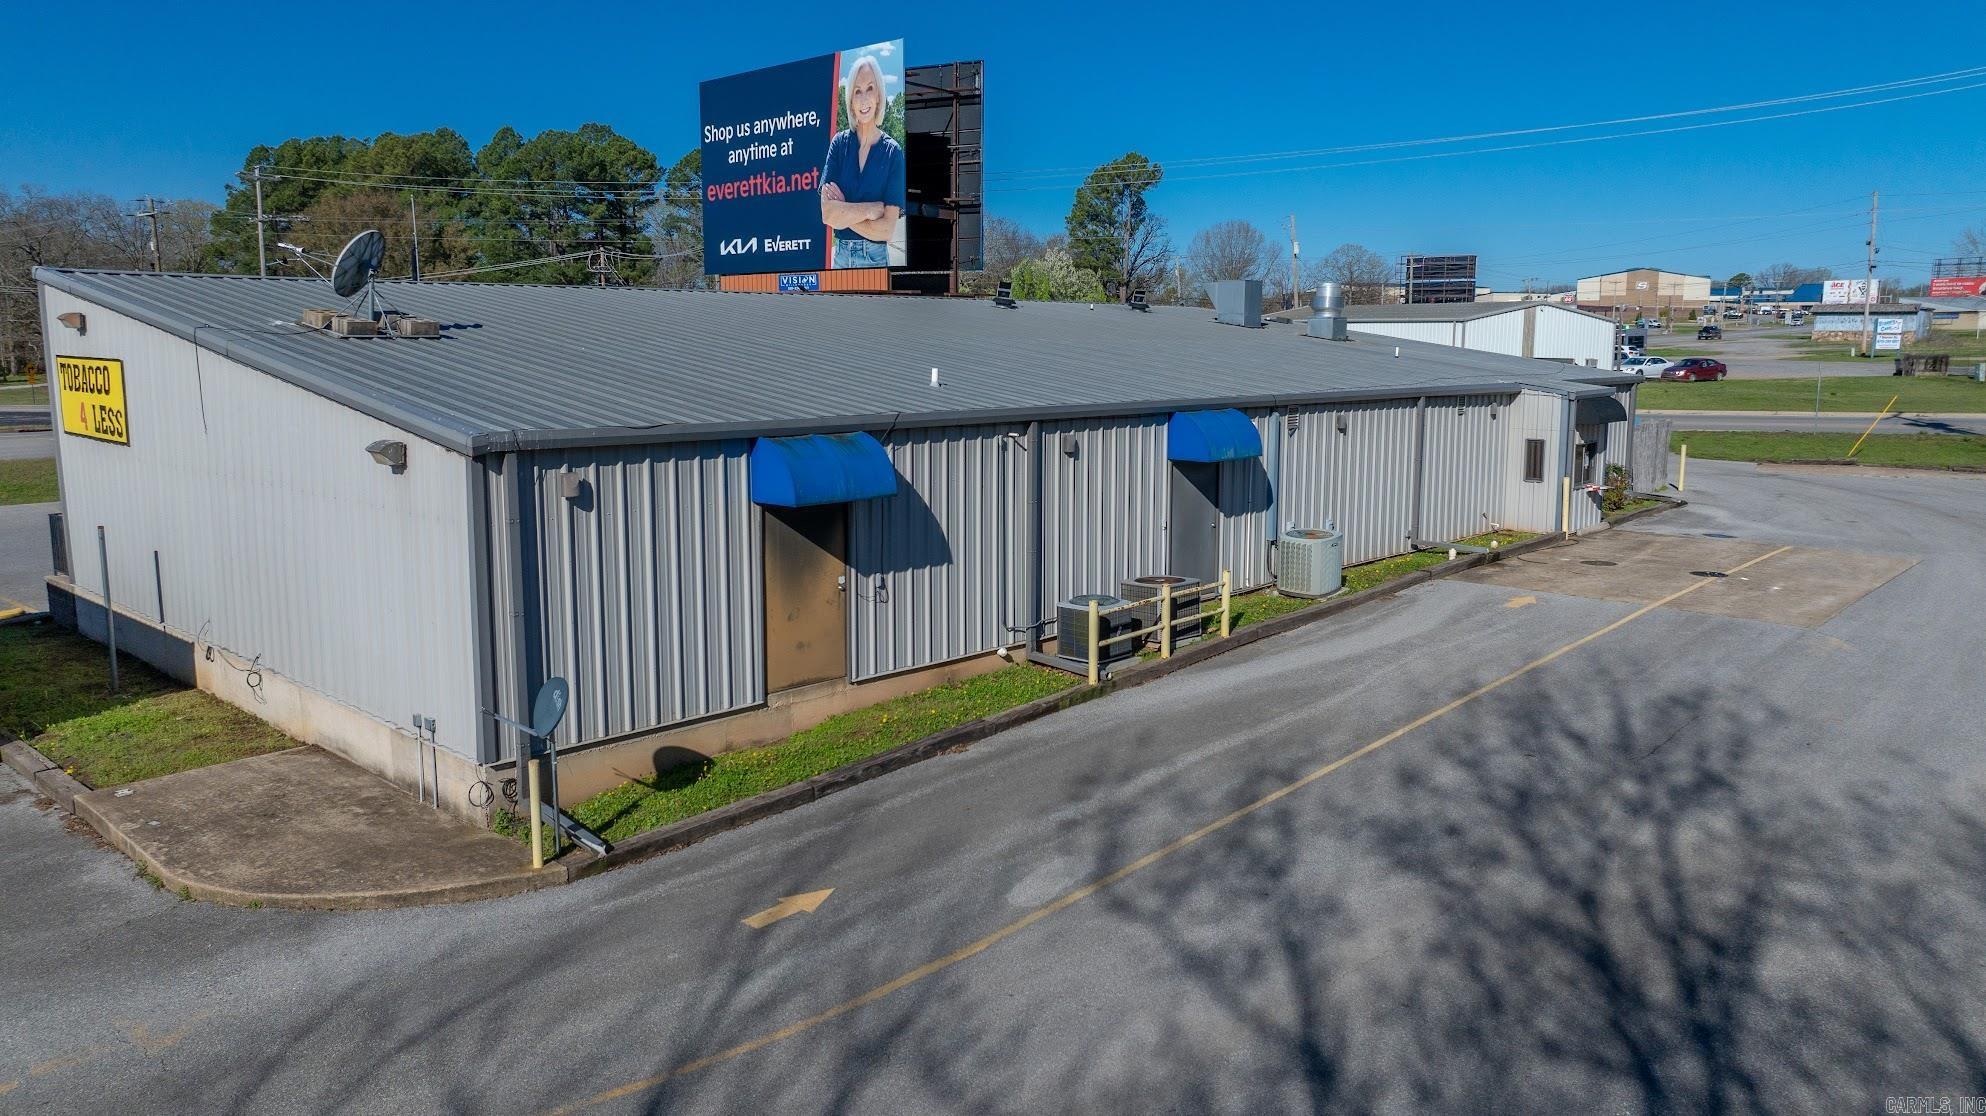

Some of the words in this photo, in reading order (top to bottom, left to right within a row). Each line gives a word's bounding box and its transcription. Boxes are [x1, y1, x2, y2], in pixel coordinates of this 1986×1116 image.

[704, 124, 733, 144] Shop
[737, 122, 750, 137] us
[754, 110, 820, 136] anywhere,
[728, 142, 777, 165] anytime
[781, 138, 793, 156] at
[707, 167, 819, 201] everettkia.net
[720, 237, 758, 255] KIA
[59, 363, 110, 395] TOBACCO
[80, 401, 88, 431] 4
[92, 404, 123, 438] LESS
